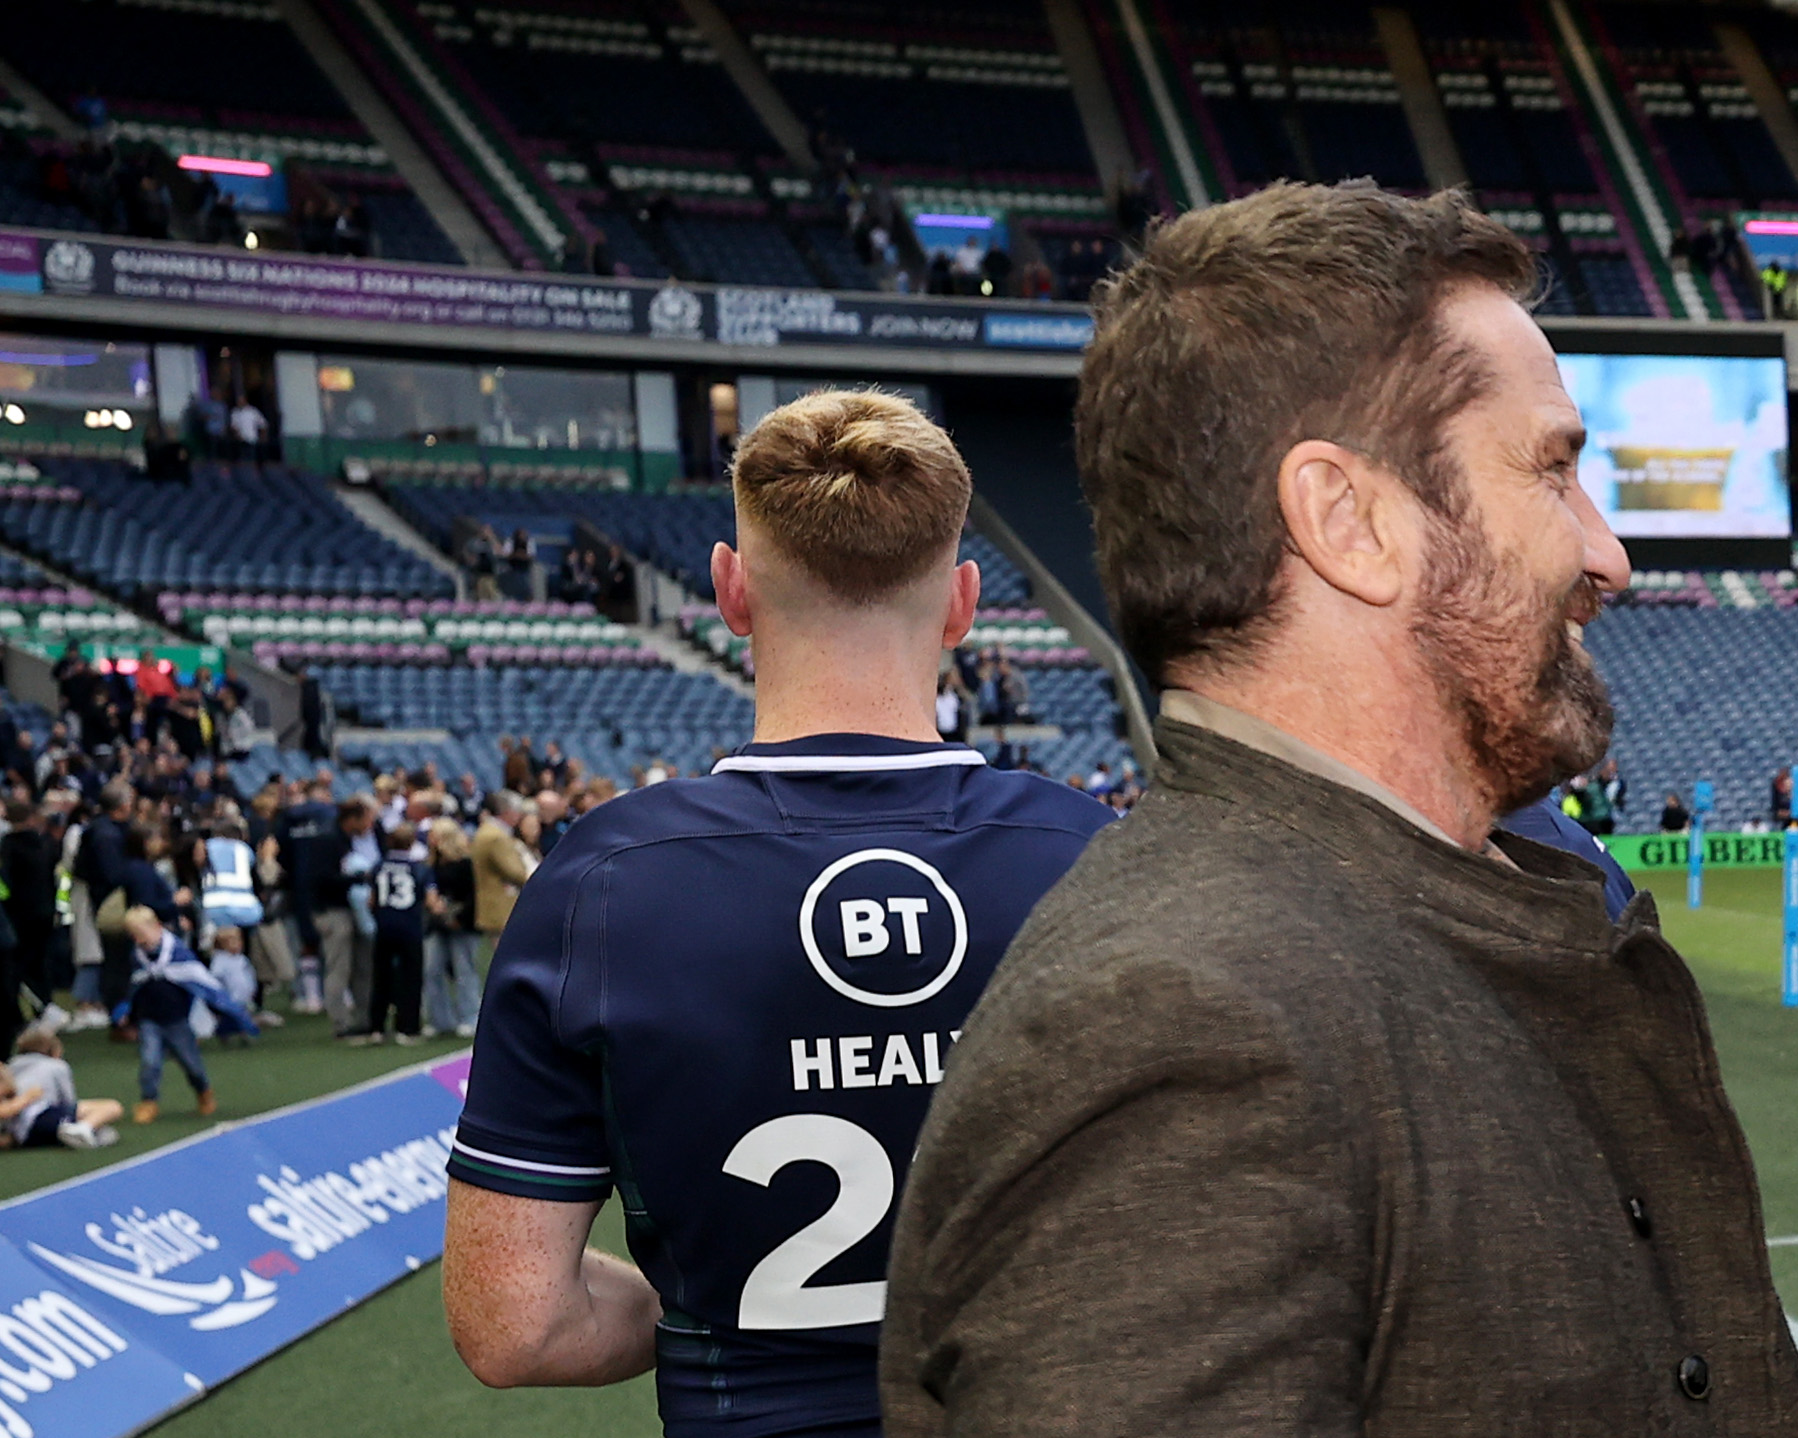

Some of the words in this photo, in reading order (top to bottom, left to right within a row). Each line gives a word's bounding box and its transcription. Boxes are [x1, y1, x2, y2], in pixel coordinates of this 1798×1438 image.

[376, 861, 416, 911] 13
[839, 896, 929, 958] BT
[790, 1031, 962, 1091] HEAL
[722, 1113, 920, 1331] 2
